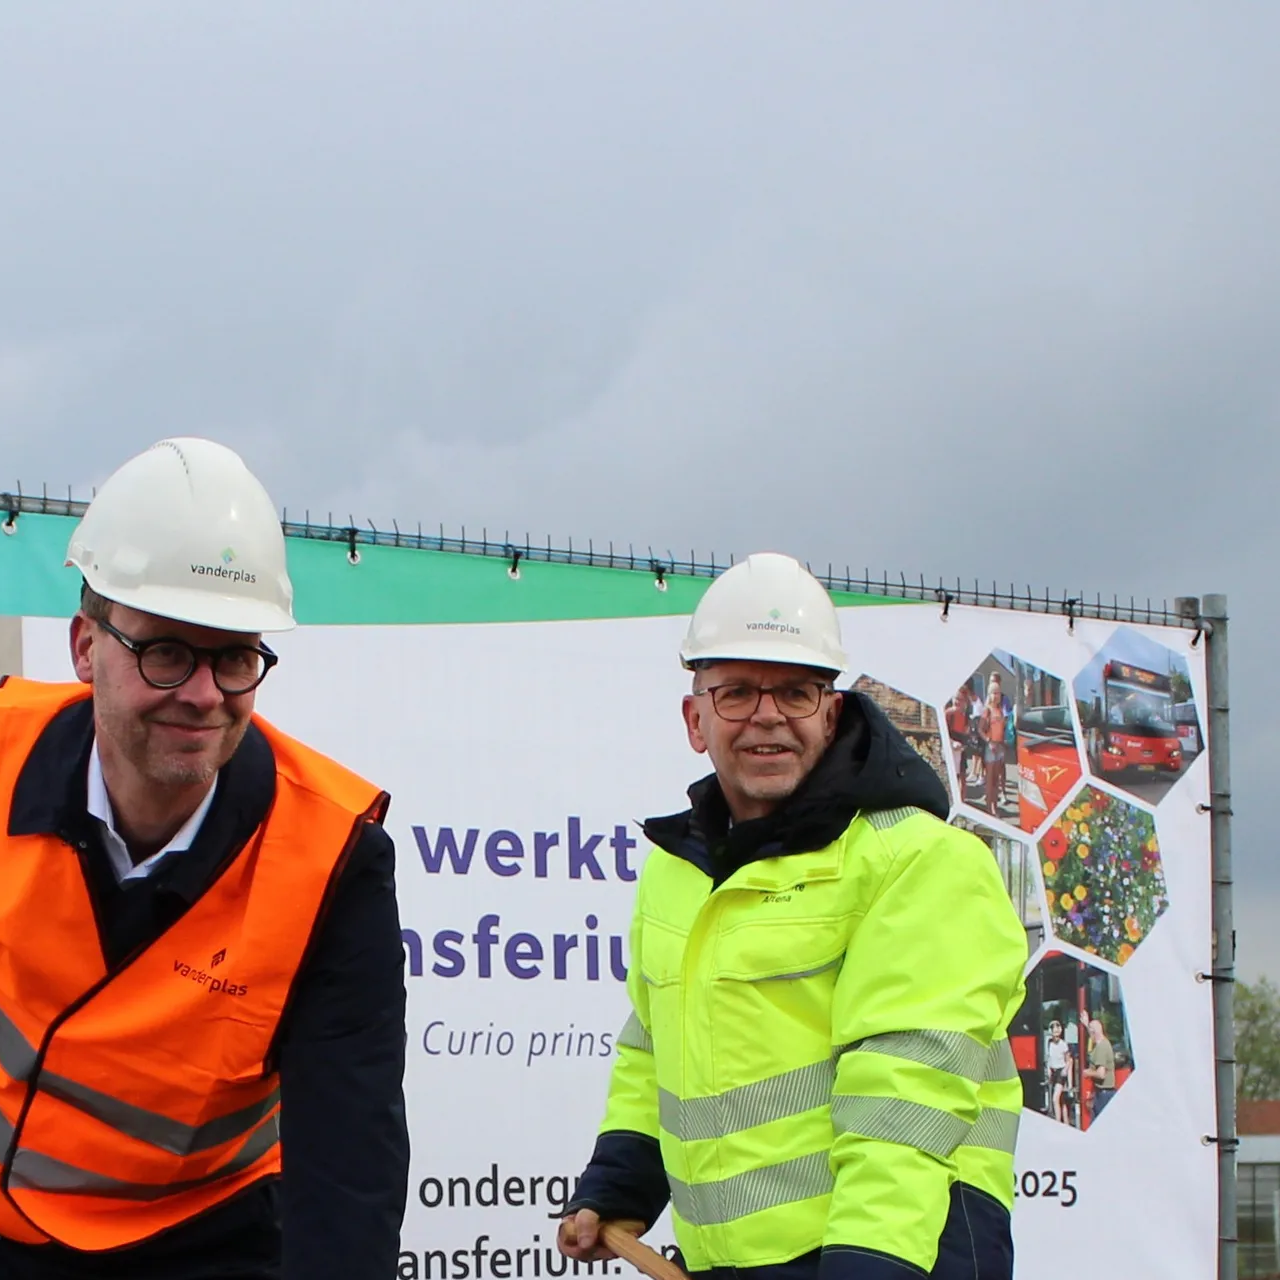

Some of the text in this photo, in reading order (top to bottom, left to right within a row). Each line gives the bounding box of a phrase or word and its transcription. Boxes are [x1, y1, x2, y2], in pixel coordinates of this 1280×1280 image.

[190, 564, 257, 585] vanderplas
[746, 621, 801, 635] vanderplas
[411, 816, 638, 882] werkt
[400, 914, 629, 982] nsferiu
[422, 1020, 614, 1067] Curio prins
[418, 1163, 579, 1219] onderg
[397, 1235, 622, 1280] ansferium.
